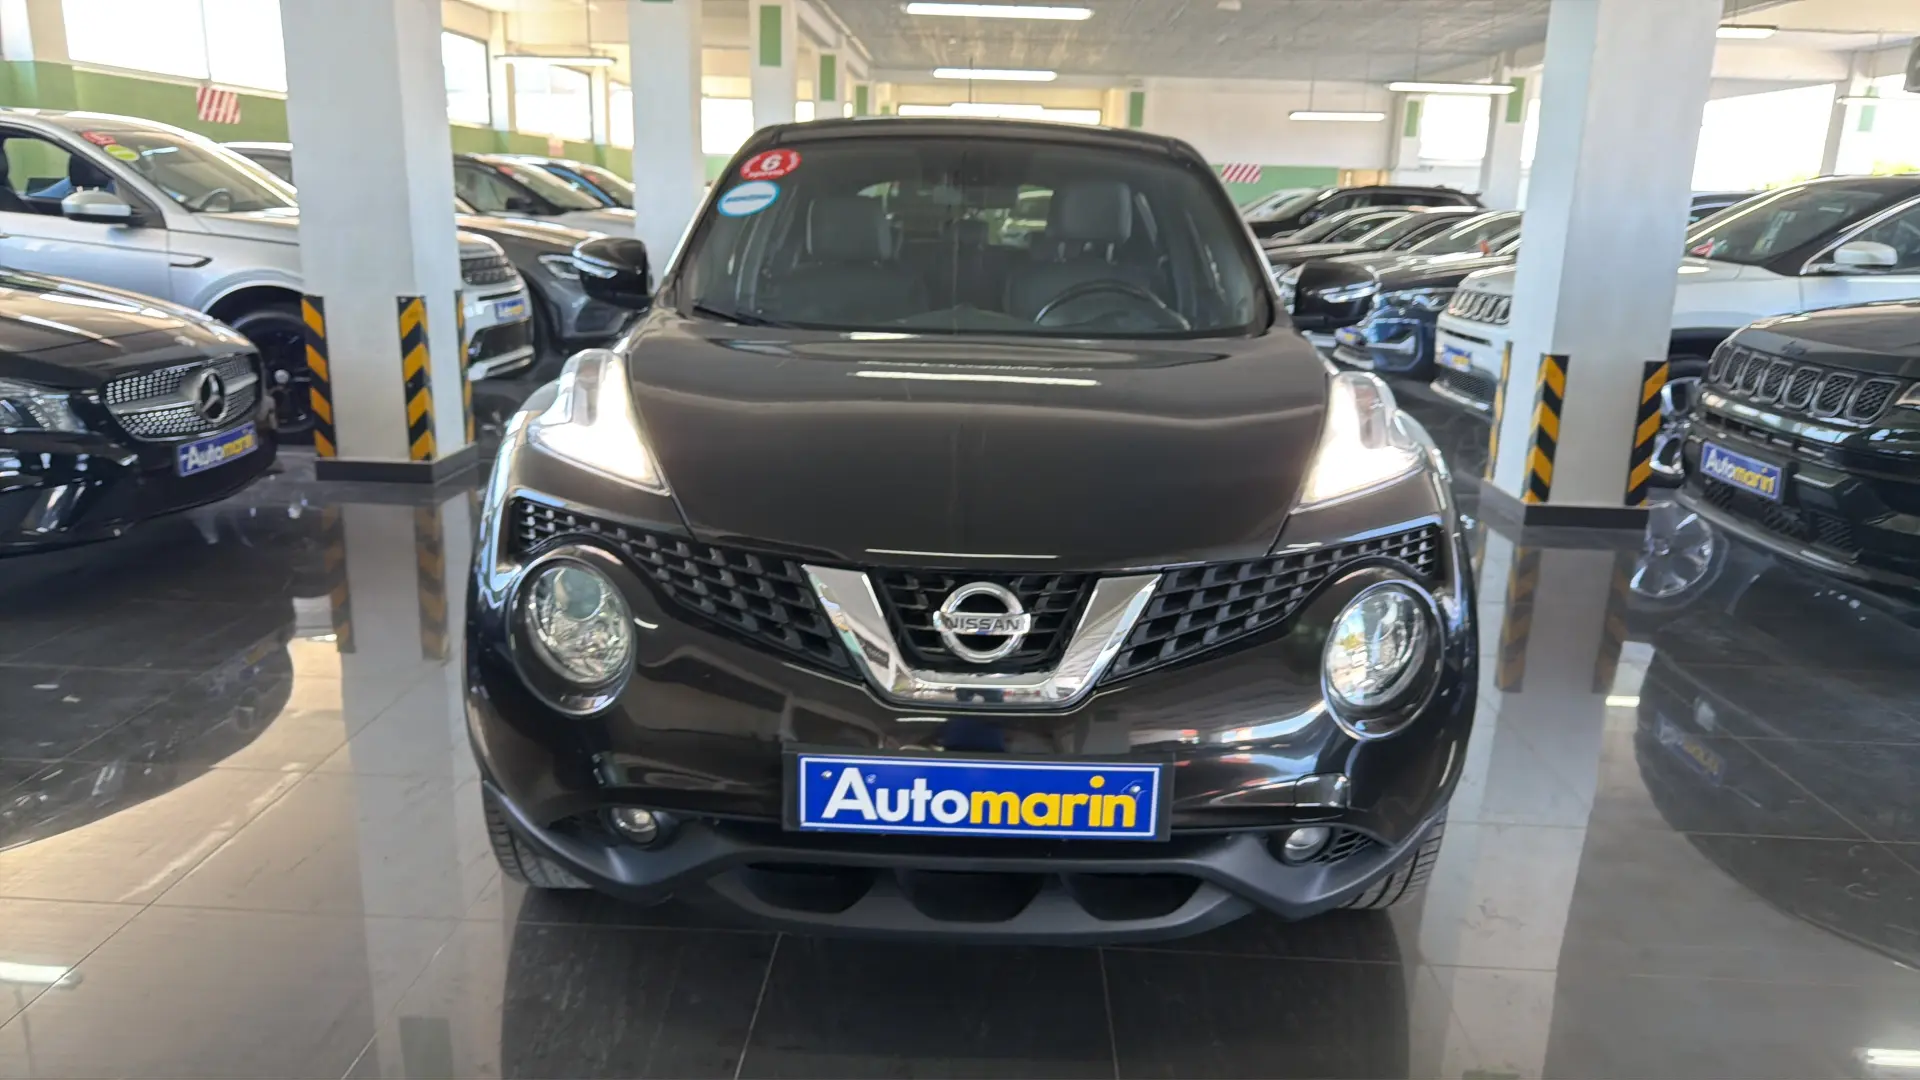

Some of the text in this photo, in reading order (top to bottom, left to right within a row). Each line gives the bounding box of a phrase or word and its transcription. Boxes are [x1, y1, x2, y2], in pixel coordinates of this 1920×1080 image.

[759, 153, 783, 172] 6
[941, 617, 1020, 631] NISSAN
[820, 766, 1137, 828] Automarin
